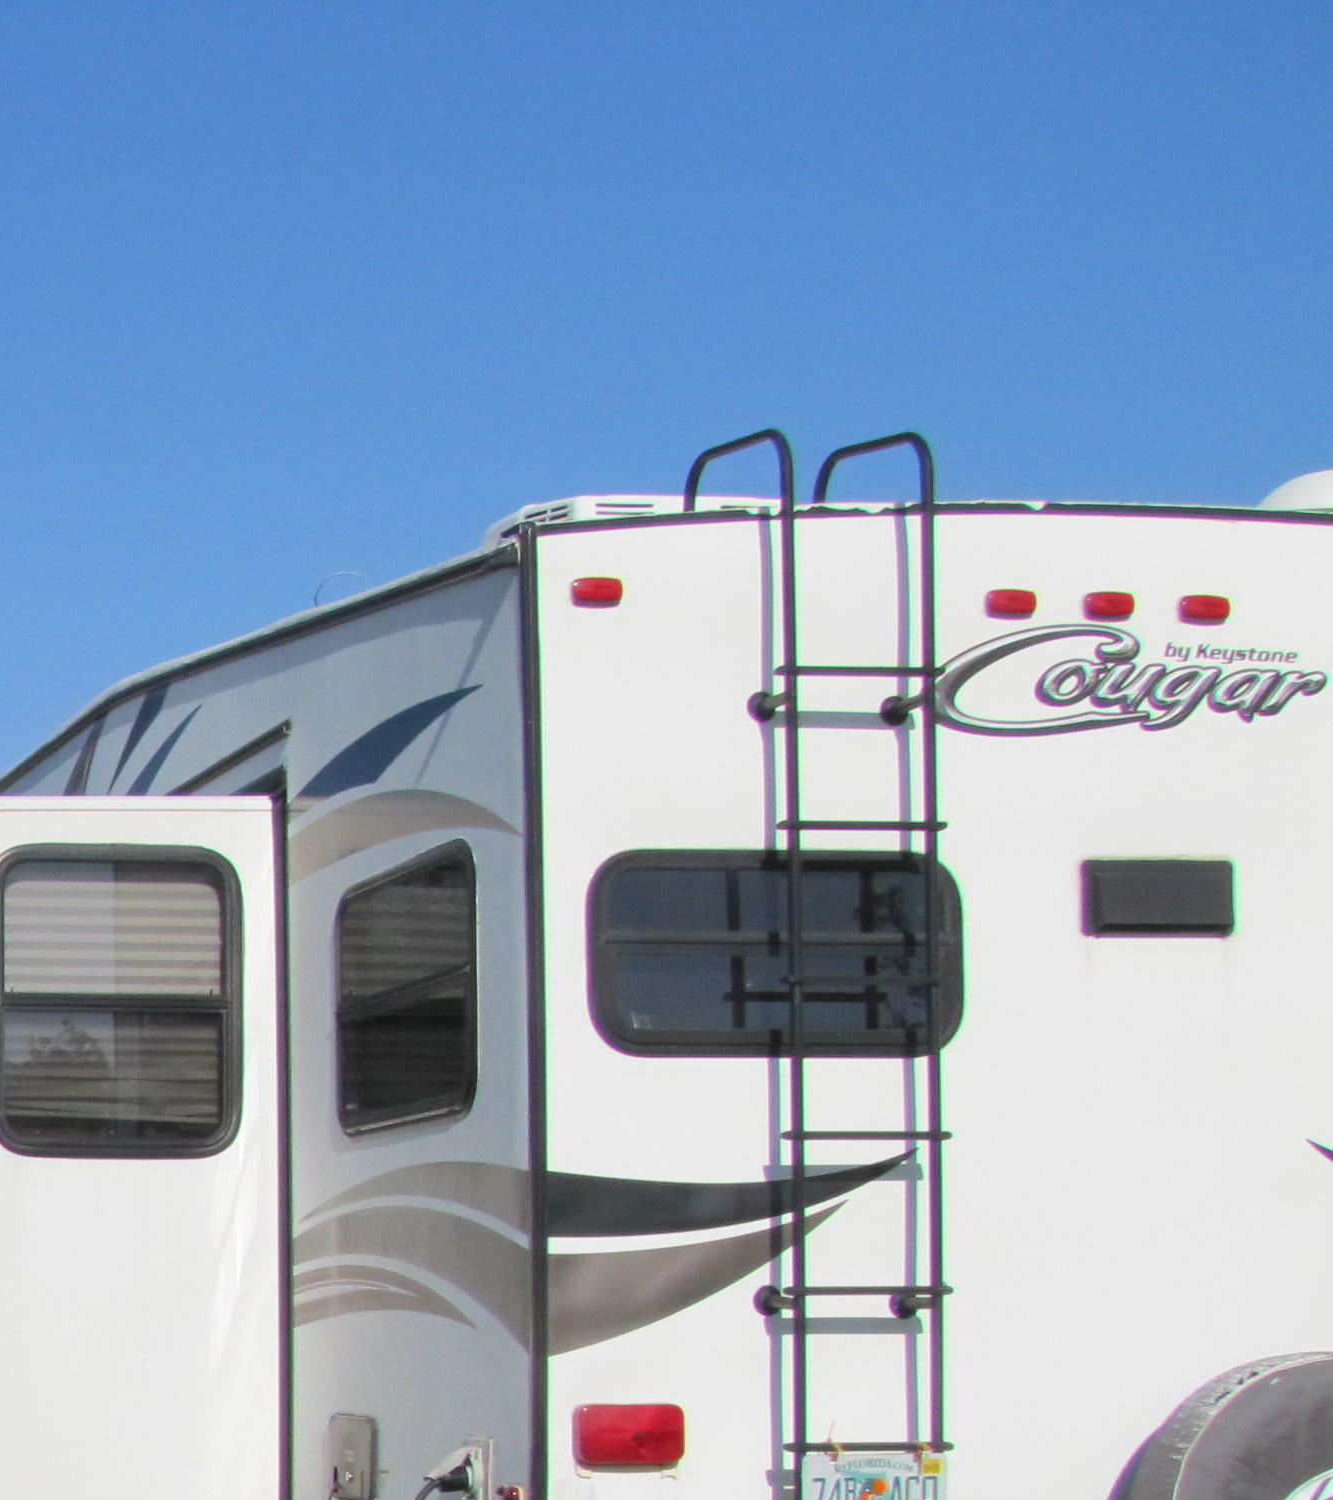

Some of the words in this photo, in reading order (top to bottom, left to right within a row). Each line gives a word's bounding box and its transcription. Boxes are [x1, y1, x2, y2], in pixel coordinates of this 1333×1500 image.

[935, 624, 1328, 737] Cougar
[1164, 642, 1191, 663] by
[1195, 643, 1299, 664] Keystone
